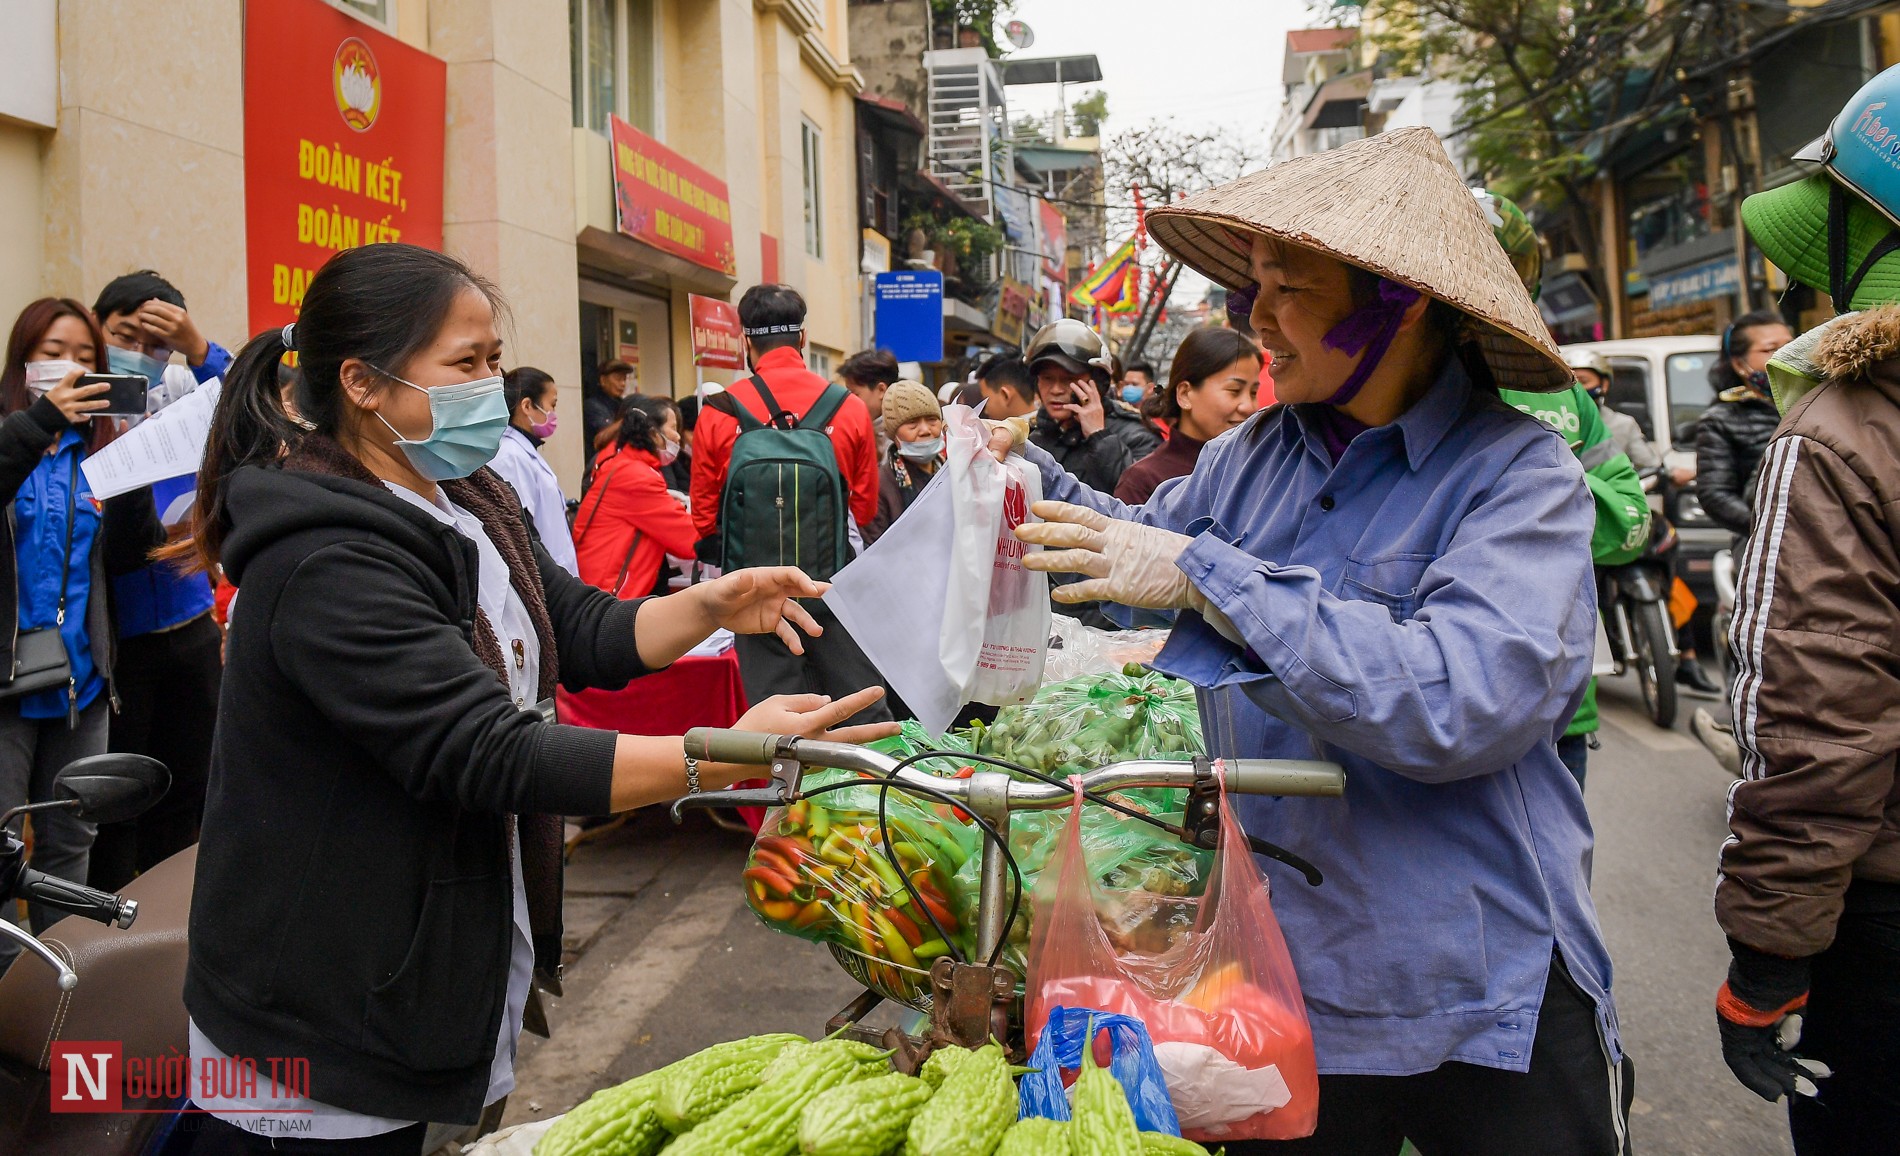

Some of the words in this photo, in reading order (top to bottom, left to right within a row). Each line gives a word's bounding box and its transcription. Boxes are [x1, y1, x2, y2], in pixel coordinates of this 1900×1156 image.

[299, 138, 360, 195] ĐOÀN
[365, 156, 407, 212] KẾT,
[298, 203, 359, 251] ĐOÀN
